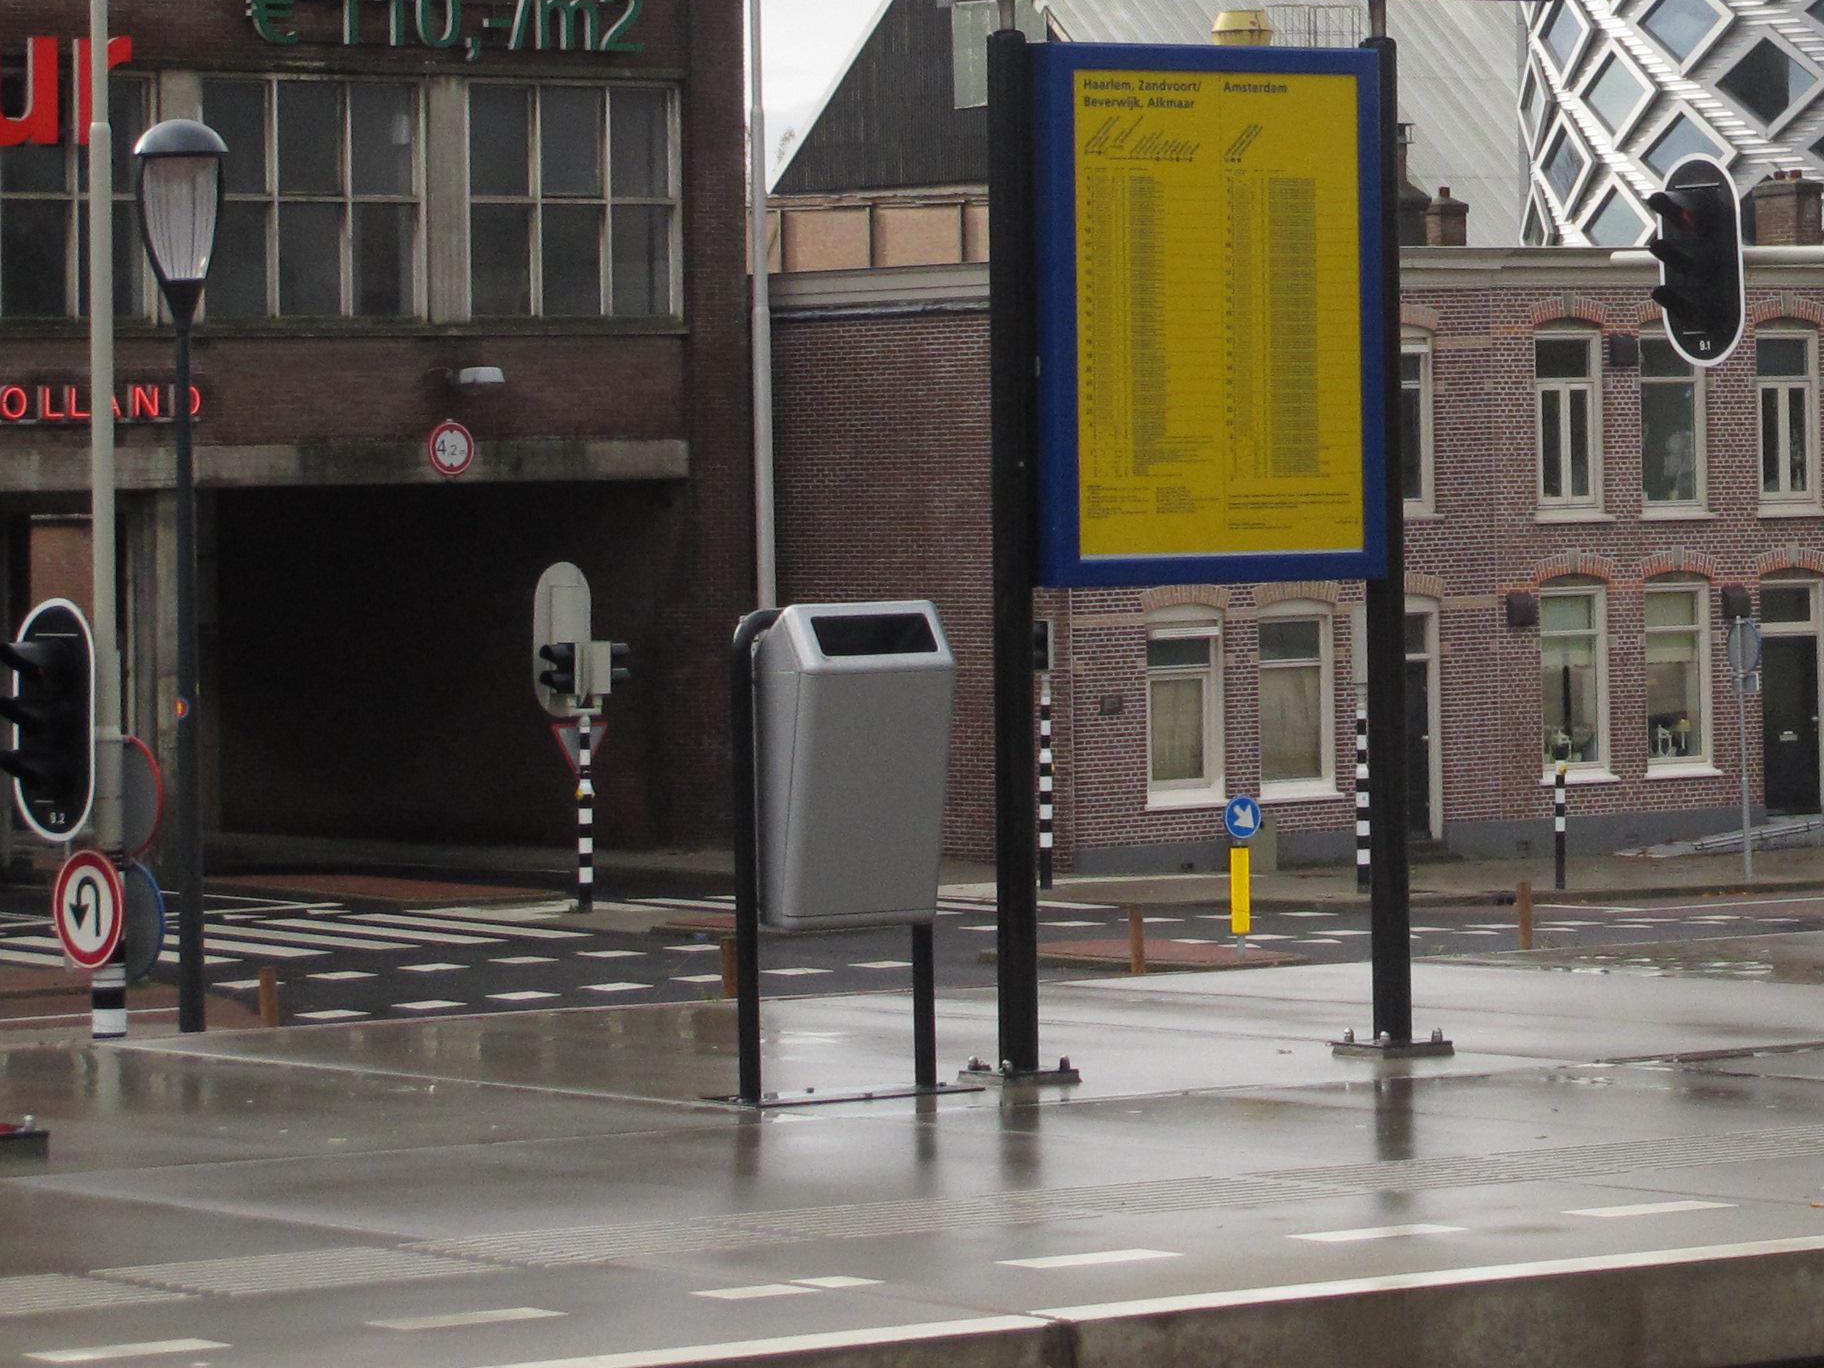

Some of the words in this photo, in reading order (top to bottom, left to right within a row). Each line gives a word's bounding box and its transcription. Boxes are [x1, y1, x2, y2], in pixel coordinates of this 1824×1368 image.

[1223, 81, 1288, 94] Amsterdam
[1147, 97, 1195, 109] Alkmaar
[0, 384, 201, 420] OLLN
